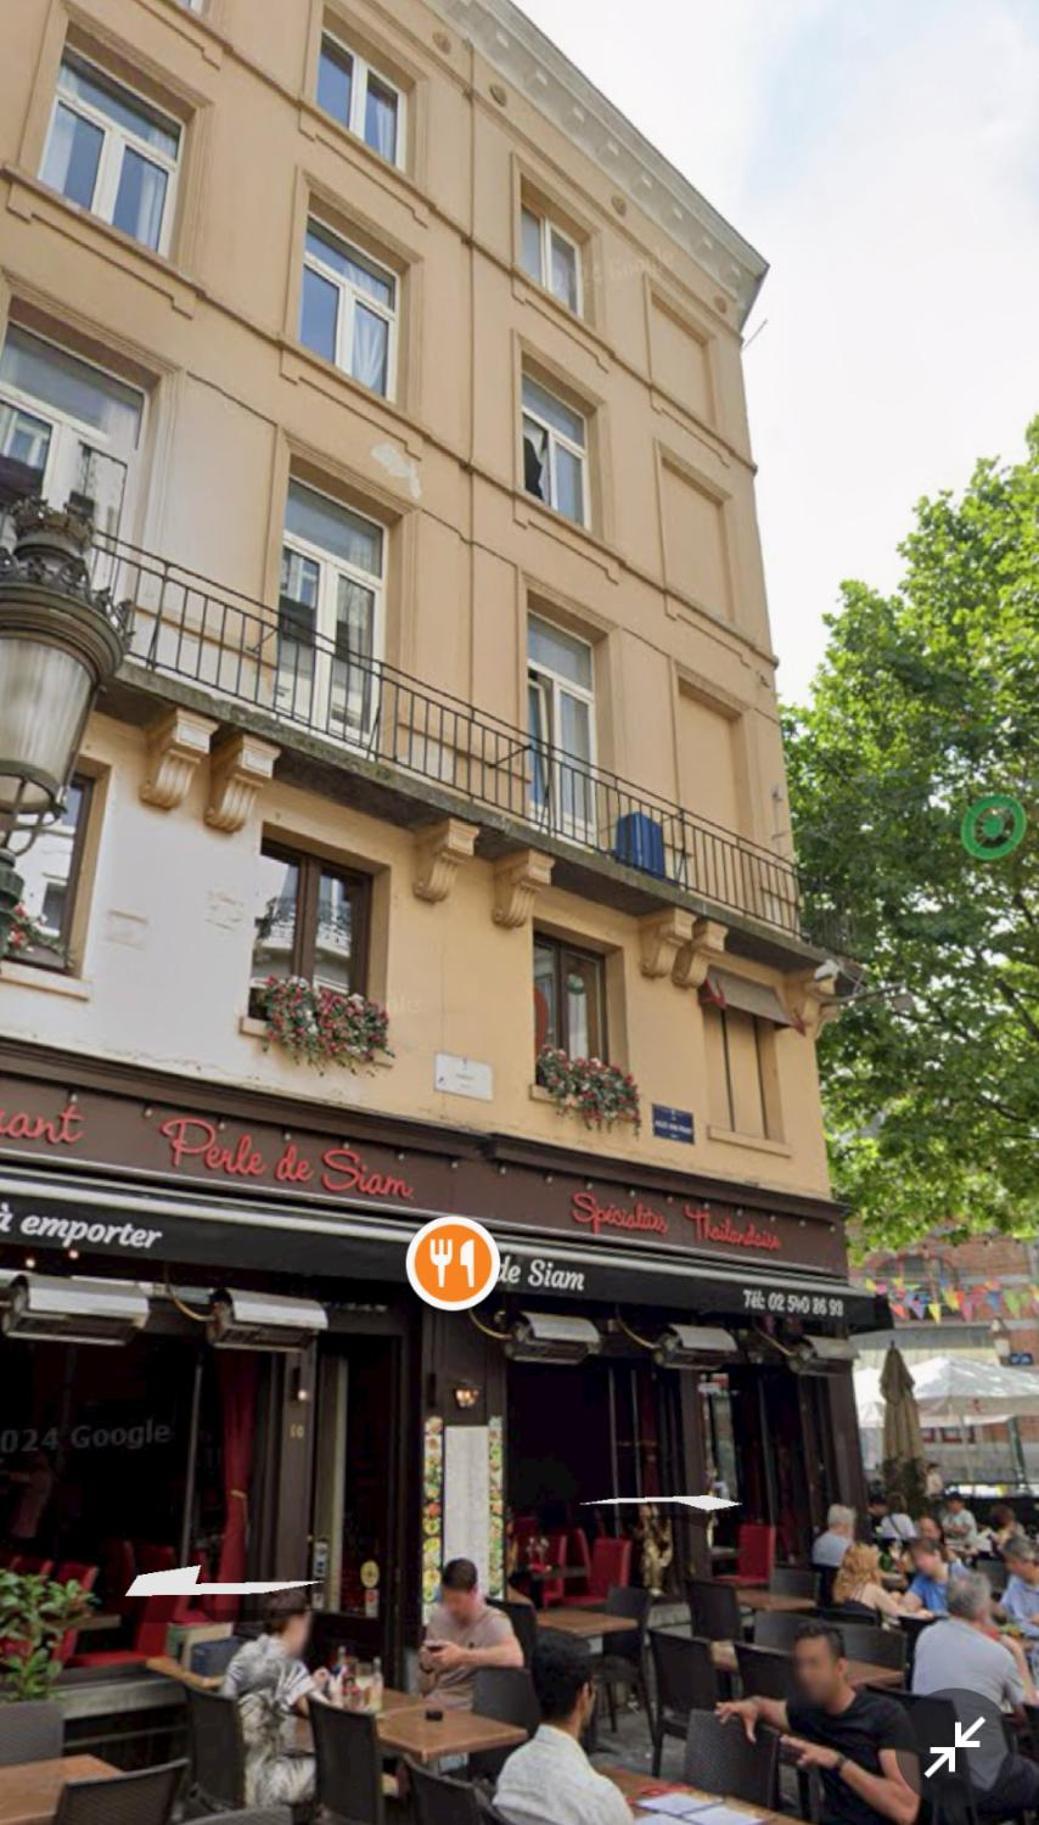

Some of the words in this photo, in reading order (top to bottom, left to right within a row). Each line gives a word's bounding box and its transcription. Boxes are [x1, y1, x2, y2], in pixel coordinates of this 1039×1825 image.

[0, 1104, 85, 1144] ant
[160, 1118, 266, 1176] Perle
[275, 1145, 313, 1182] de
[322, 1148, 414, 1197] Siam
[20, 1214, 162, 1248] emporter
[499, 1255, 521, 1284] de
[527, 1259, 585, 1291] Siam
[767, 1292, 785, 1312] 02
